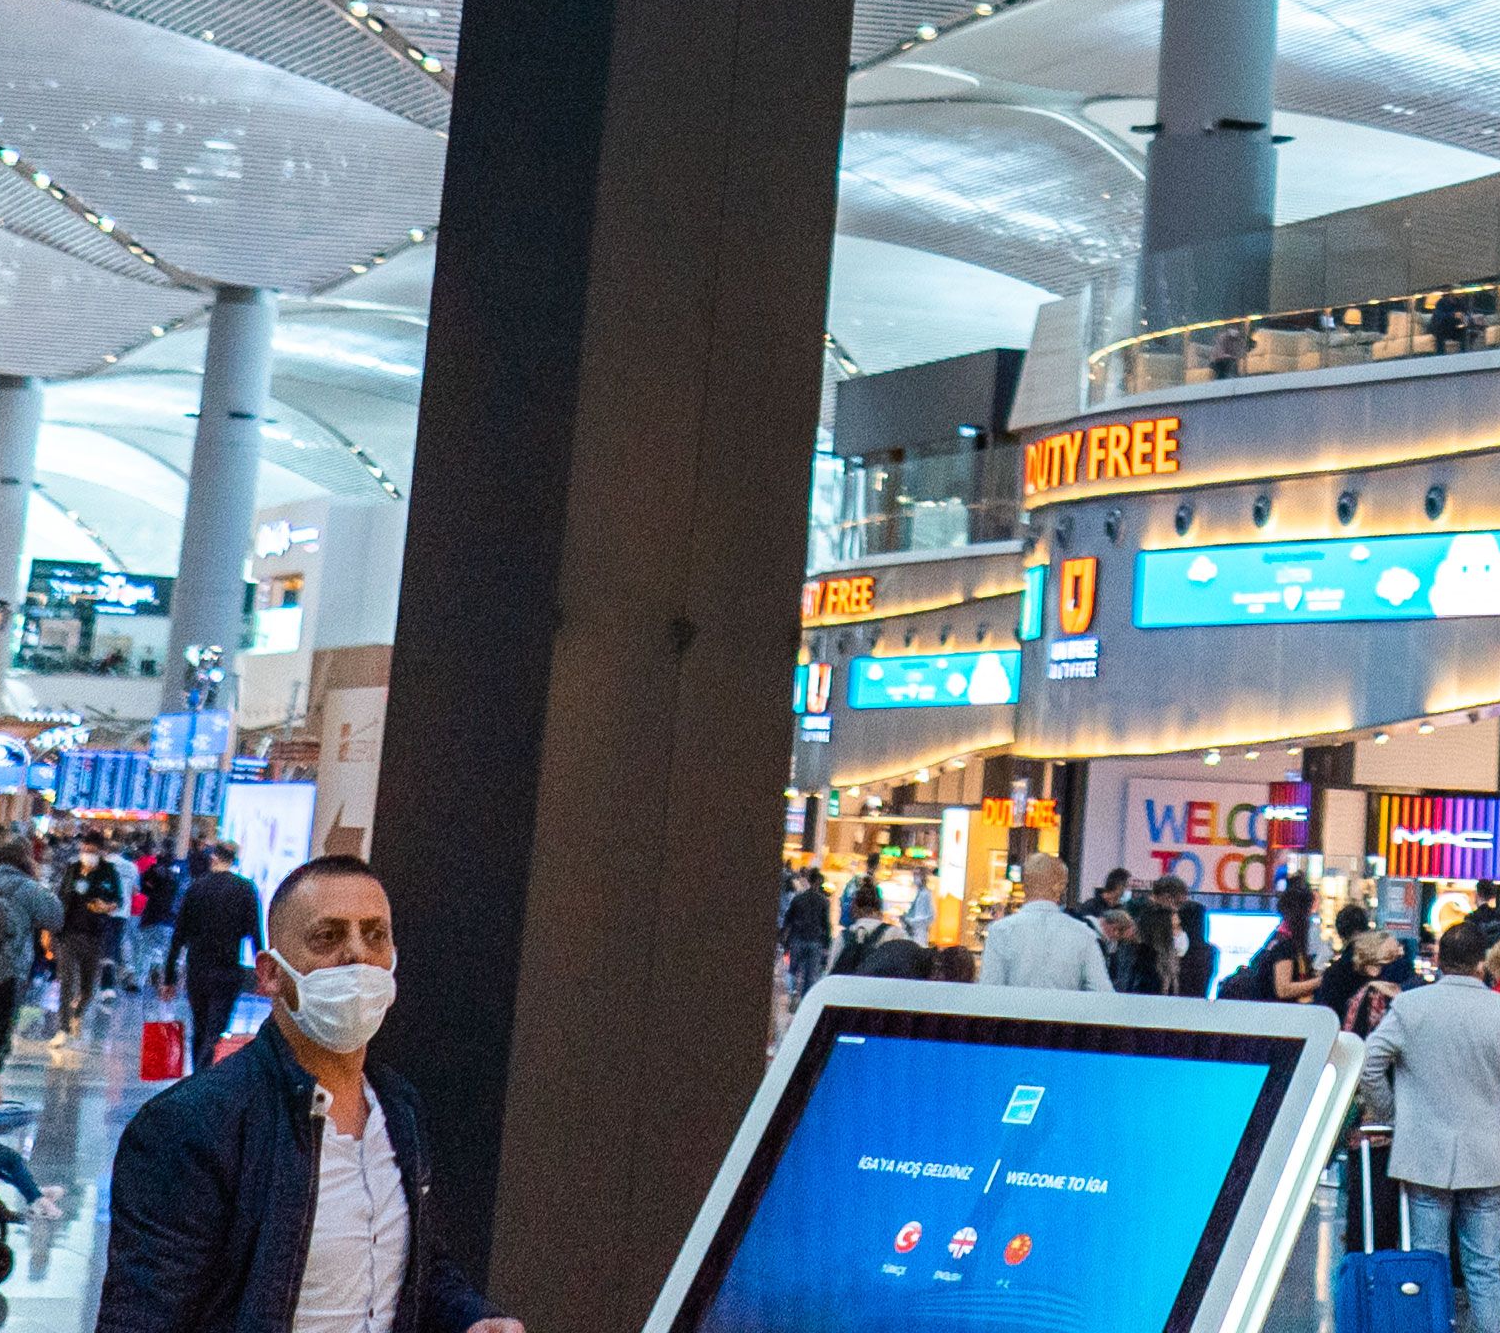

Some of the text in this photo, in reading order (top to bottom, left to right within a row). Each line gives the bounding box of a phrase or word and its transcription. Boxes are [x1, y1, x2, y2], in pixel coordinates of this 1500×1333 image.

[1024, 416, 1181, 496] DUTY FREE
[826, 576, 876, 615] FREE
[982, 796, 1016, 827] DUT
[1393, 827, 1494, 850] MAC
[1005, 1170, 1066, 1189] WELCOME
[1067, 1174, 1085, 1190] TO
